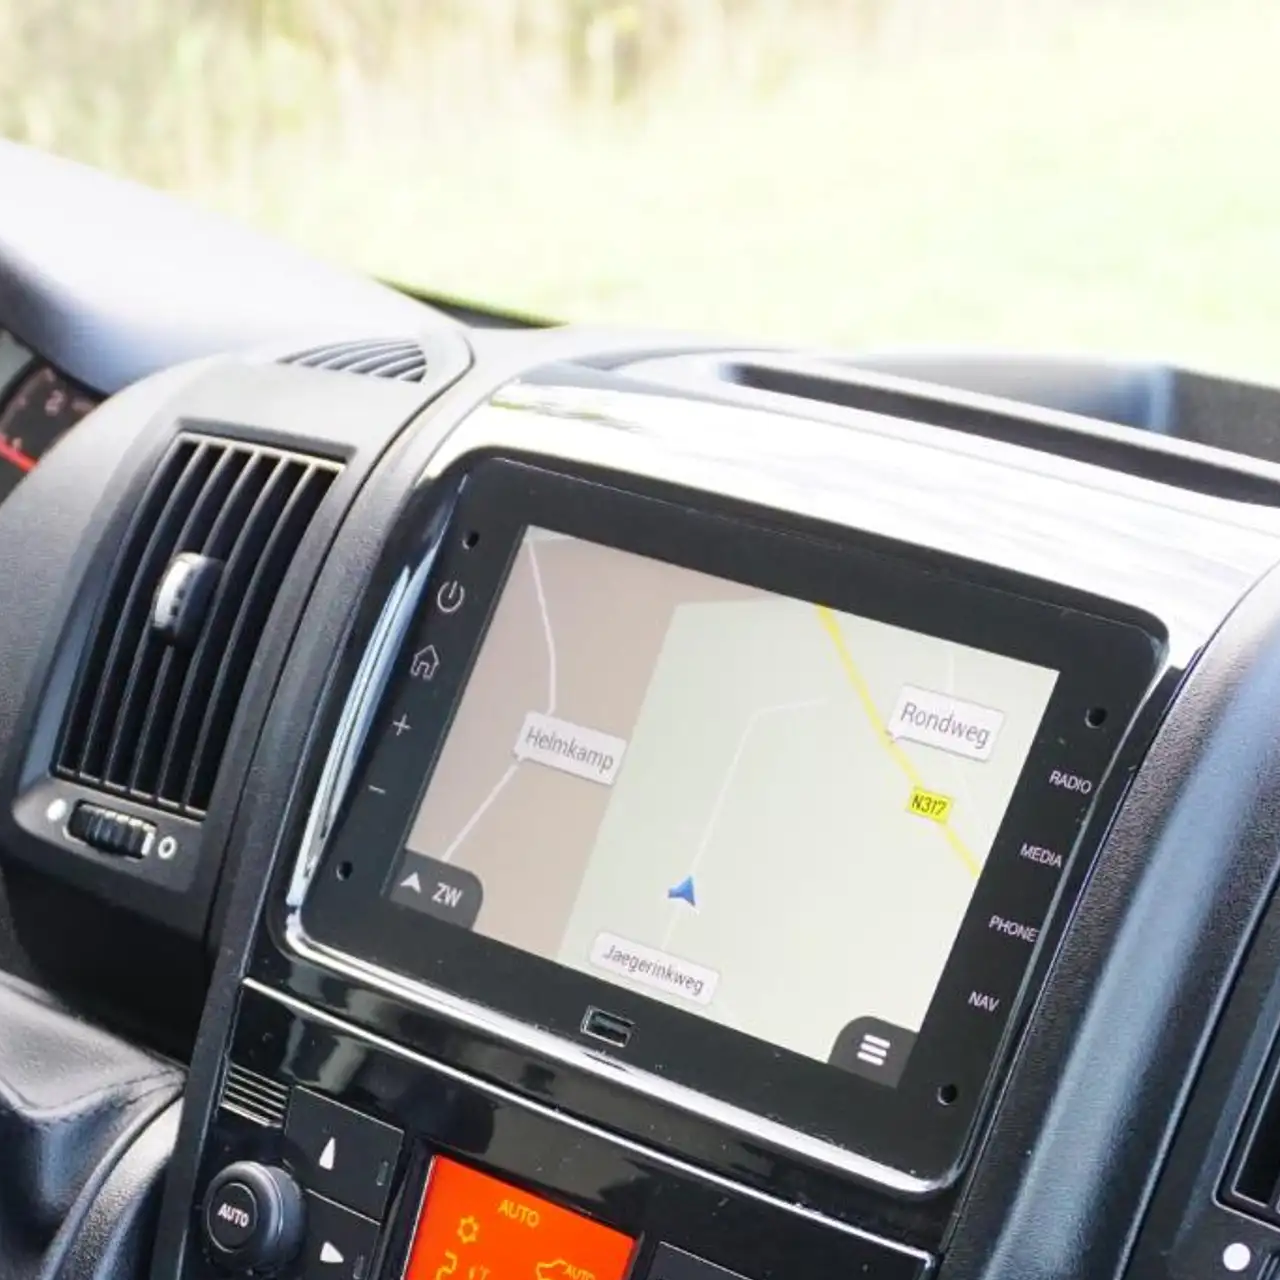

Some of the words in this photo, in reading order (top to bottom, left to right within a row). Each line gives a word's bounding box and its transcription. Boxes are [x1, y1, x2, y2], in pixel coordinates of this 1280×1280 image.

[900, 701, 992, 750] Rondweg
[524, 725, 614, 774] Helmkamp
[1048, 770, 1092, 794] RADIO
[910, 793, 948, 816] N317
[1020, 842, 1063, 867] MEDIA
[431, 880, 464, 909] ZW
[988, 914, 1038, 943] PHONE
[601, 944, 705, 997] Jaegerinkweg
[967, 989, 1000, 1012] NAV
[217, 1202, 250, 1228] AUTO
[497, 1199, 540, 1228] AUTO
